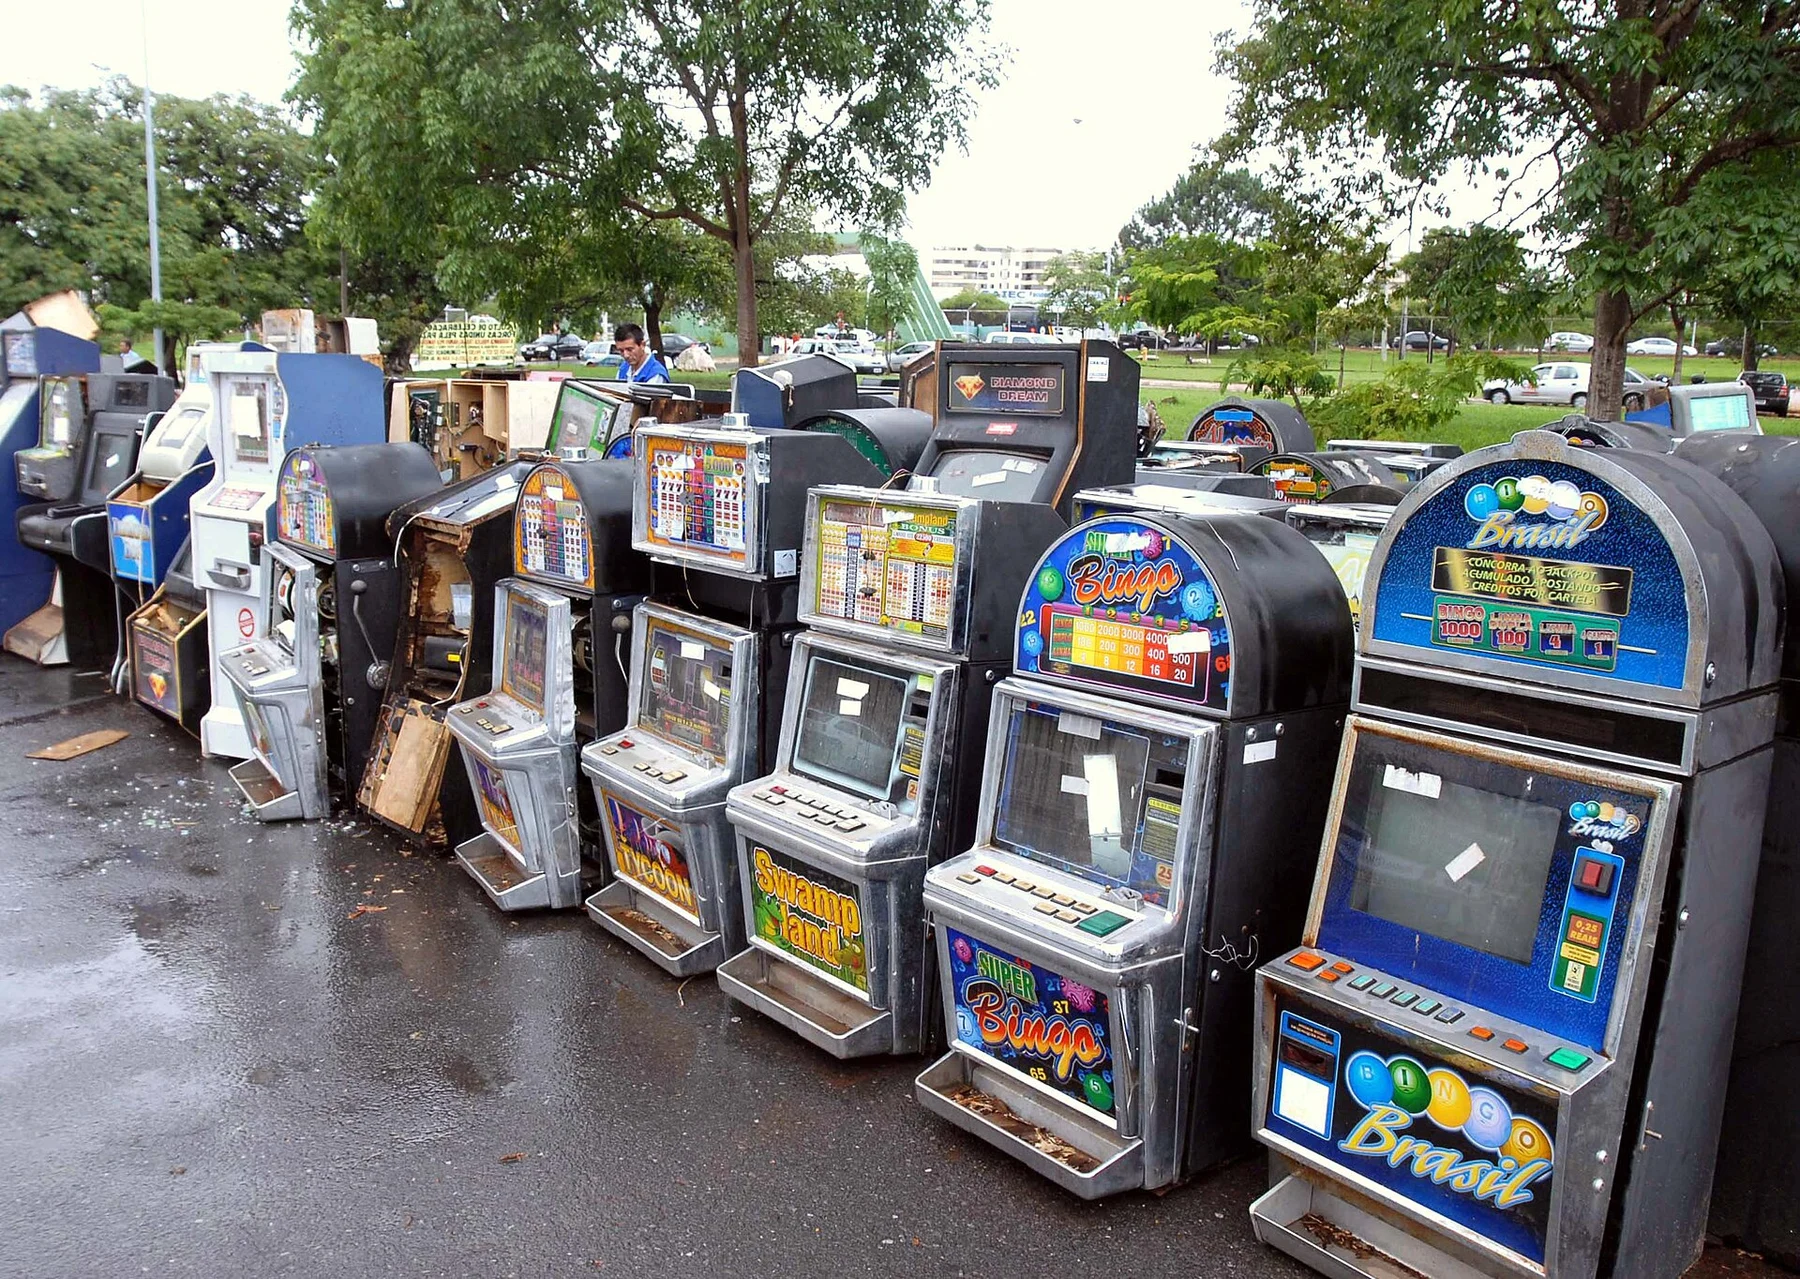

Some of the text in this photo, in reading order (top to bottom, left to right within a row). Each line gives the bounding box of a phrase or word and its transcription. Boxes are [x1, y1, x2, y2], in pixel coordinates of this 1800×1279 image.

[990, 377, 1057, 390] DIAMOND
[998, 390, 1049, 403] DREAM
[901, 523, 945, 535] BONUS
[1467, 509, 1600, 549] Brasil
[1162, 536, 1171, 550] 7
[1469, 557, 1525, 574] CONCORRA
[1545, 567, 1598, 581] JACKPOT
[1069, 553, 1180, 613] Bingo
[1463, 569, 1601, 594] ACUMULADO APOSTANDO
[1190, 590, 1200, 604] 2
[1523, 588, 1545, 599] POR
[1547, 591, 1597, 606] CARTELA
[1106, 609, 1116, 620] 2
[1131, 613, 1141, 623] 3
[1179, 620, 1189, 631] 5
[1437, 604, 1486, 622] BINGO
[1097, 623, 1120, 636] 2000
[1121, 627, 1143, 641] 3000
[1146, 632, 1168, 646] 4000
[1440, 620, 1482, 638] 1000
[1496, 630, 1527, 645] 100
[1549, 634, 1562, 649] 4
[1594, 642, 1603, 655] 1
[1099, 639, 1116, 652] 200
[1123, 643, 1140, 656] 300
[1147, 648, 1165, 661] 400
[1172, 653, 1190, 666] 500
[1126, 659, 1136, 671] 12
[1149, 664, 1160, 676] 16
[1174, 669, 1187, 681] 20
[1568, 817, 1635, 840] Brasil
[619, 842, 693, 907] TYCOON
[1157, 865, 1172, 880] 25
[754, 847, 861, 938] Swamp
[779, 899, 842, 970] land
[1570, 930, 1598, 945] REAIS
[978, 950, 1037, 1004] SUPER
[1045, 977, 1061, 991] 27
[1052, 1000, 1070, 1014] 37
[964, 976, 1104, 1082] Bingo
[1029, 1067, 1047, 1081] 65
[1090, 1079, 1101, 1093] 5
[1337, 1103, 1554, 1210] Brasil
